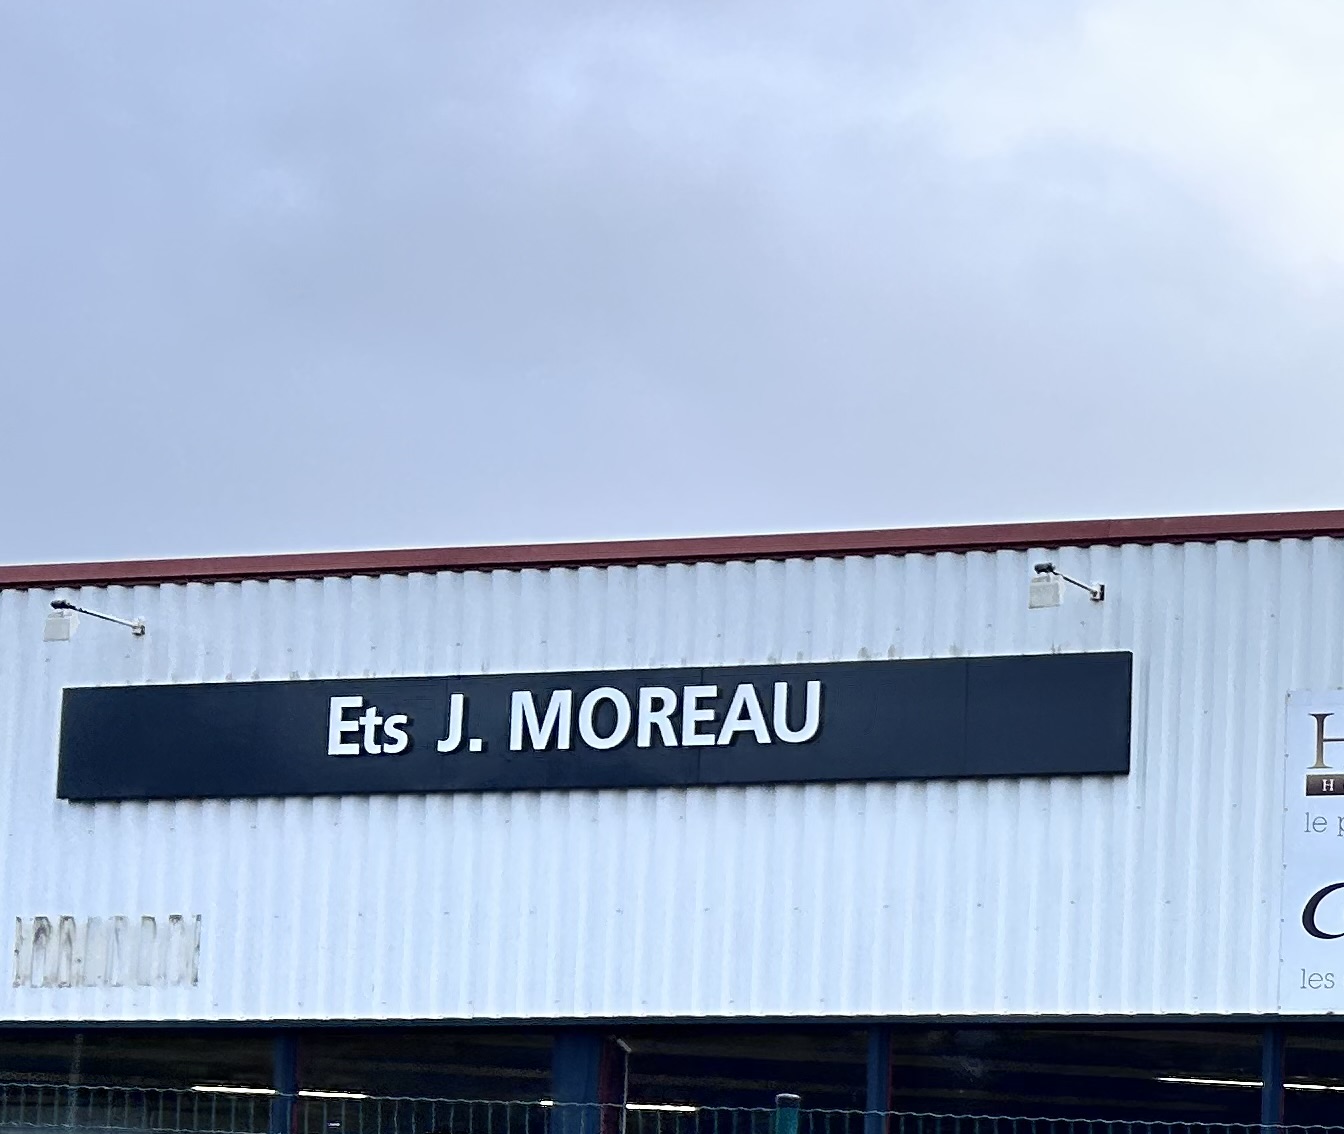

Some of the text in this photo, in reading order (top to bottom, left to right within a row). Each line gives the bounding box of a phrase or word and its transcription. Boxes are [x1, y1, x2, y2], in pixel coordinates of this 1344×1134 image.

[328, 681, 824, 757] Ets J. MOREAU
[1304, 811, 1328, 833] le
[1300, 968, 1334, 990] les
